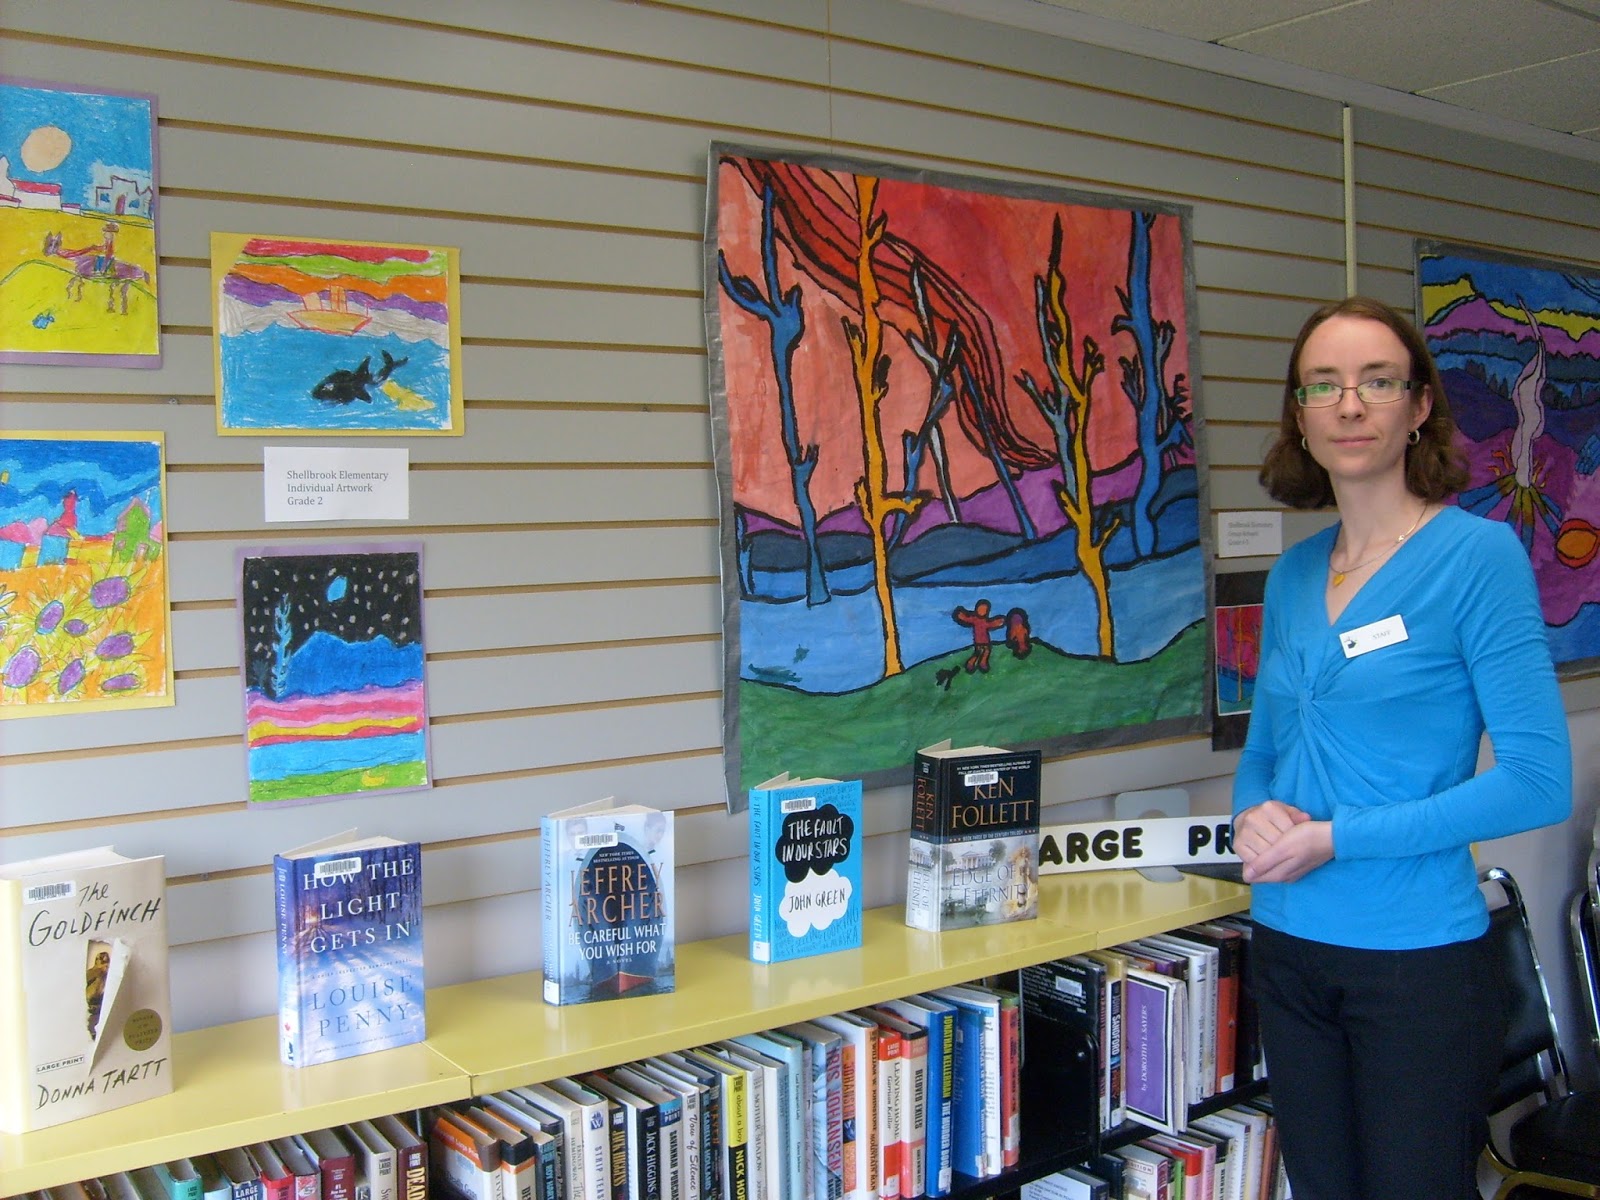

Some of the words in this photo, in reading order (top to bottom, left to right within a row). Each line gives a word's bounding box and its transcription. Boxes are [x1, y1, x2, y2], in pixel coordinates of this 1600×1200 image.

[287, 470, 337, 480] Shellbrook
[339, 470, 389, 481] Elementary
[287, 483, 334, 492] Individual
[336, 483, 373, 492] Artwork
[287, 496, 315, 505] Grade
[317, 496, 323, 505] 2
[1373, 630, 1391, 639] STAFF
[974, 776, 1014, 800] KEN
[915, 778, 926, 831] FOLLETT
[926, 793, 935, 820] KEN
[952, 800, 1035, 829] FOLLETT
[788, 819, 812, 841] THE
[814, 815, 844, 840] FAULT
[782, 843, 796, 863] IN
[795, 841, 815, 862] OUR
[814, 837, 848, 860] STARS
[1038, 827, 1143, 867] ARGE
[1188, 824, 1236, 857] PR
[367, 858, 414, 881] THE
[570, 862, 663, 900] JEFFREY
[953, 867, 993, 887] EDGE
[997, 863, 1017, 881] OF
[79, 882, 109, 907] The
[321, 892, 400, 920] LIGHT
[753, 893, 762, 912] JOHN
[788, 893, 812, 914] JOHN
[815, 887, 846, 909] GREEN
[569, 892, 667, 927] ARCHER
[311, 927, 376, 954] GETS
[386, 921, 410, 940] IN
[569, 931, 580, 946] BE
[583, 928, 631, 945] CAREFUL
[634, 923, 667, 938] WHAT
[753, 914, 762, 938] GREEN
[579, 945, 603, 961] YOU
[605, 943, 633, 957] WISH
[636, 940, 657, 954] FOR
[312, 975, 413, 1011] LOUISE
[319, 1003, 410, 1037] PENNY
[943, 1015, 954, 1054] JONATHAN
[1111, 1014, 1120, 1056] SANDFORD
[37, 1061, 60, 1073] LARGE
[62, 1056, 84, 1067] PRINT
[826, 1047, 842, 1083] IRIS
[942, 1054, 953, 1098] KELLERMAN
[35, 1078, 95, 1110] DONNA
[103, 1057, 167, 1094] TARTT
[914, 1069, 923, 1102] BELOVED
[914, 1103, 923, 1130] EXILES
[942, 1101, 951, 1119] THE
[689, 1114, 698, 1136] Vow
[703, 1111, 711, 1150] ISABELLE
[826, 1092, 842, 1172] JOHANSEN
[941, 1119, 951, 1149] MURDER
[612, 1130, 626, 1151] JACK
[646, 1132, 656, 1154] JACK
[669, 1130, 678, 1169] SAVANNAH
[687, 1140, 697, 1151] of
[379, 1159, 391, 1168] LARGE
[379, 1167, 391, 1176] PRINT
[594, 1145, 604, 1172] STRIP
[612, 1151, 627, 1187] HIGGINS
[703, 1150, 711, 1191] HOLLAND
[735, 1149, 745, 1178] NICK
[646, 1154, 657, 1193] HIGGINS
[689, 1154, 698, 1191] Silence
[235, 1186, 258, 1198] LARGE
[596, 1177, 605, 1200] TEAS
